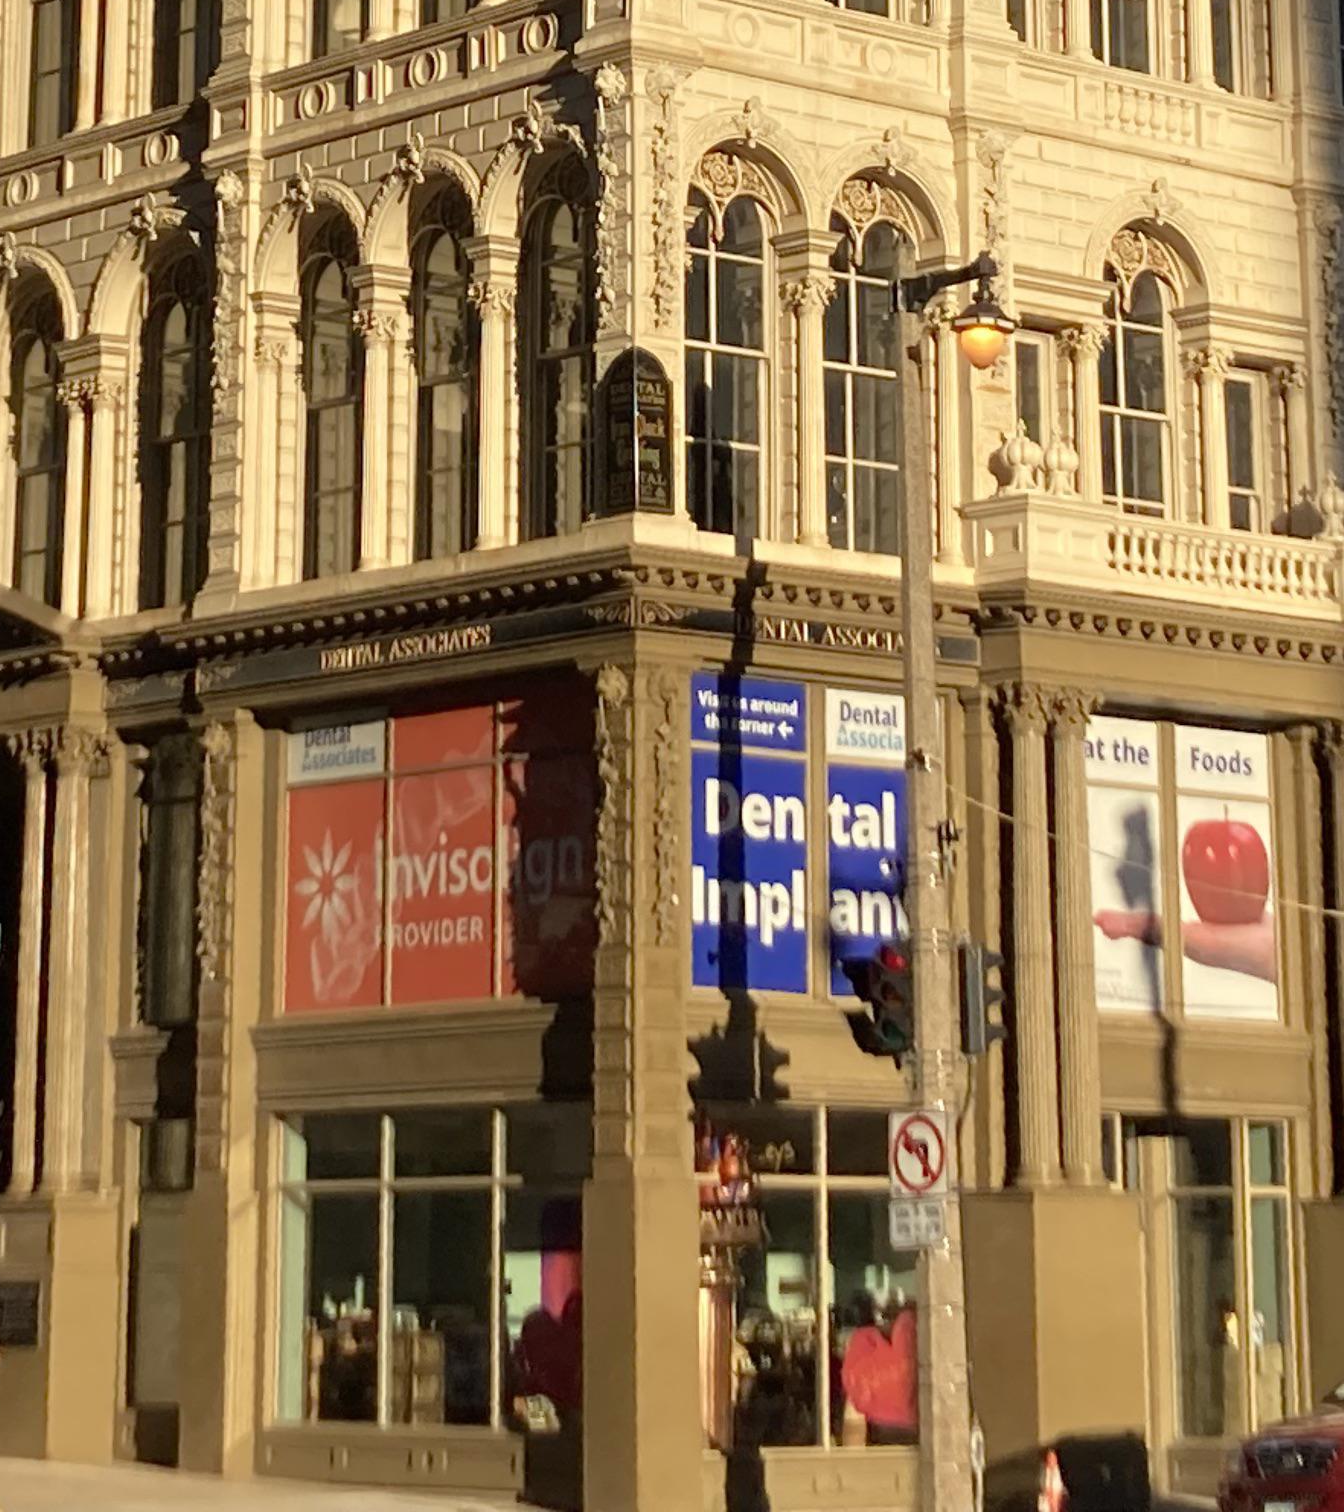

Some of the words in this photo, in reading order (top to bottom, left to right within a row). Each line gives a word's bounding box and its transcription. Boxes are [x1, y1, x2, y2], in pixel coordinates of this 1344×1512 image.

[320, 640, 385, 671] DENTAL
[388, 623, 492, 663] ASSOCIATES
[819, 623, 906, 655] ASSOCIA
[749, 697, 800, 719] around
[838, 699, 899, 729] Dental
[835, 723, 904, 752] Associa
[301, 745, 377, 773] Associates
[1112, 736, 1150, 766] the
[1190, 746, 1253, 776] Foods
[704, 776, 896, 852] Dental
